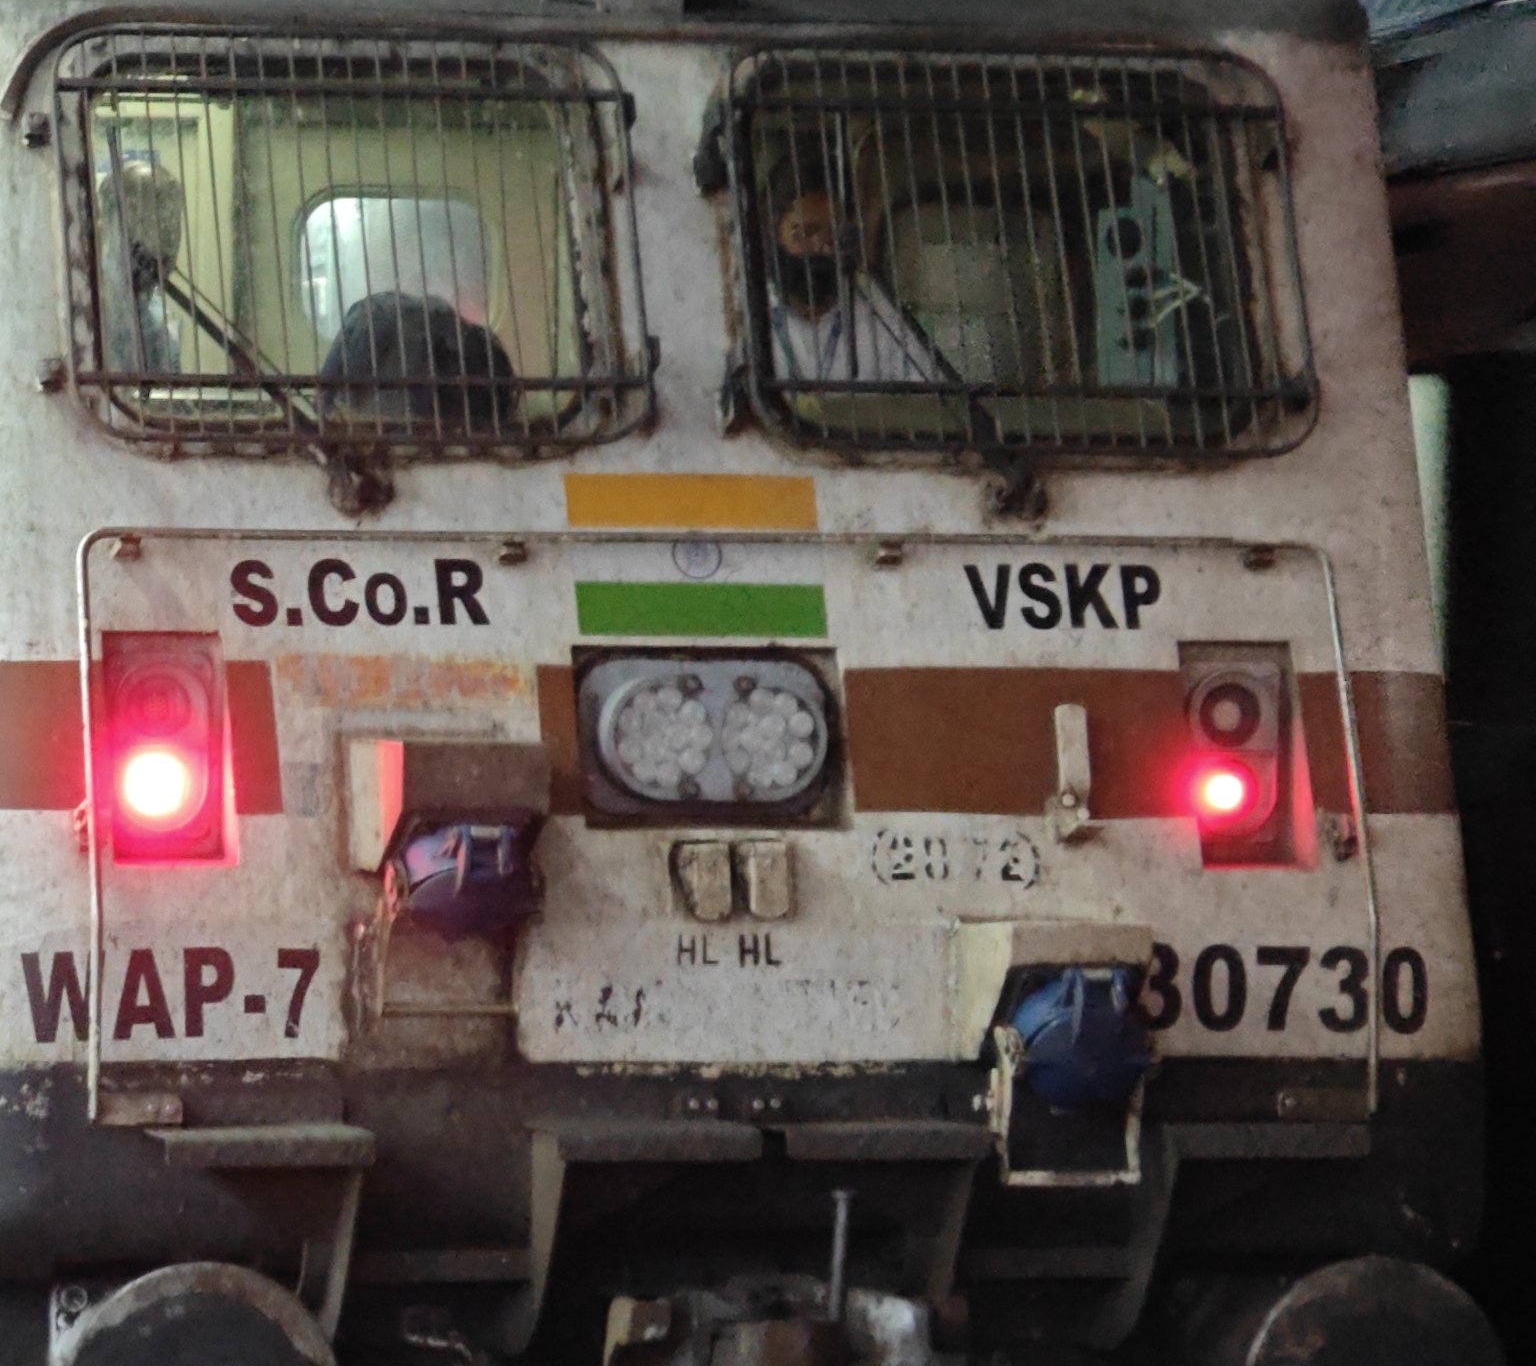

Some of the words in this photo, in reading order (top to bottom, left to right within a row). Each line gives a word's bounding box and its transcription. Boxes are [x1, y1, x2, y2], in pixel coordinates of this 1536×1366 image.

[230, 558, 490, 627] S.Co.R
[964, 562, 1161, 630] VSKP
[677, 934, 719, 966] HL
[739, 933, 782, 968] HL
[21, 946, 321, 1043] WAP-7
[1138, 942, 1428, 1035] 30730
